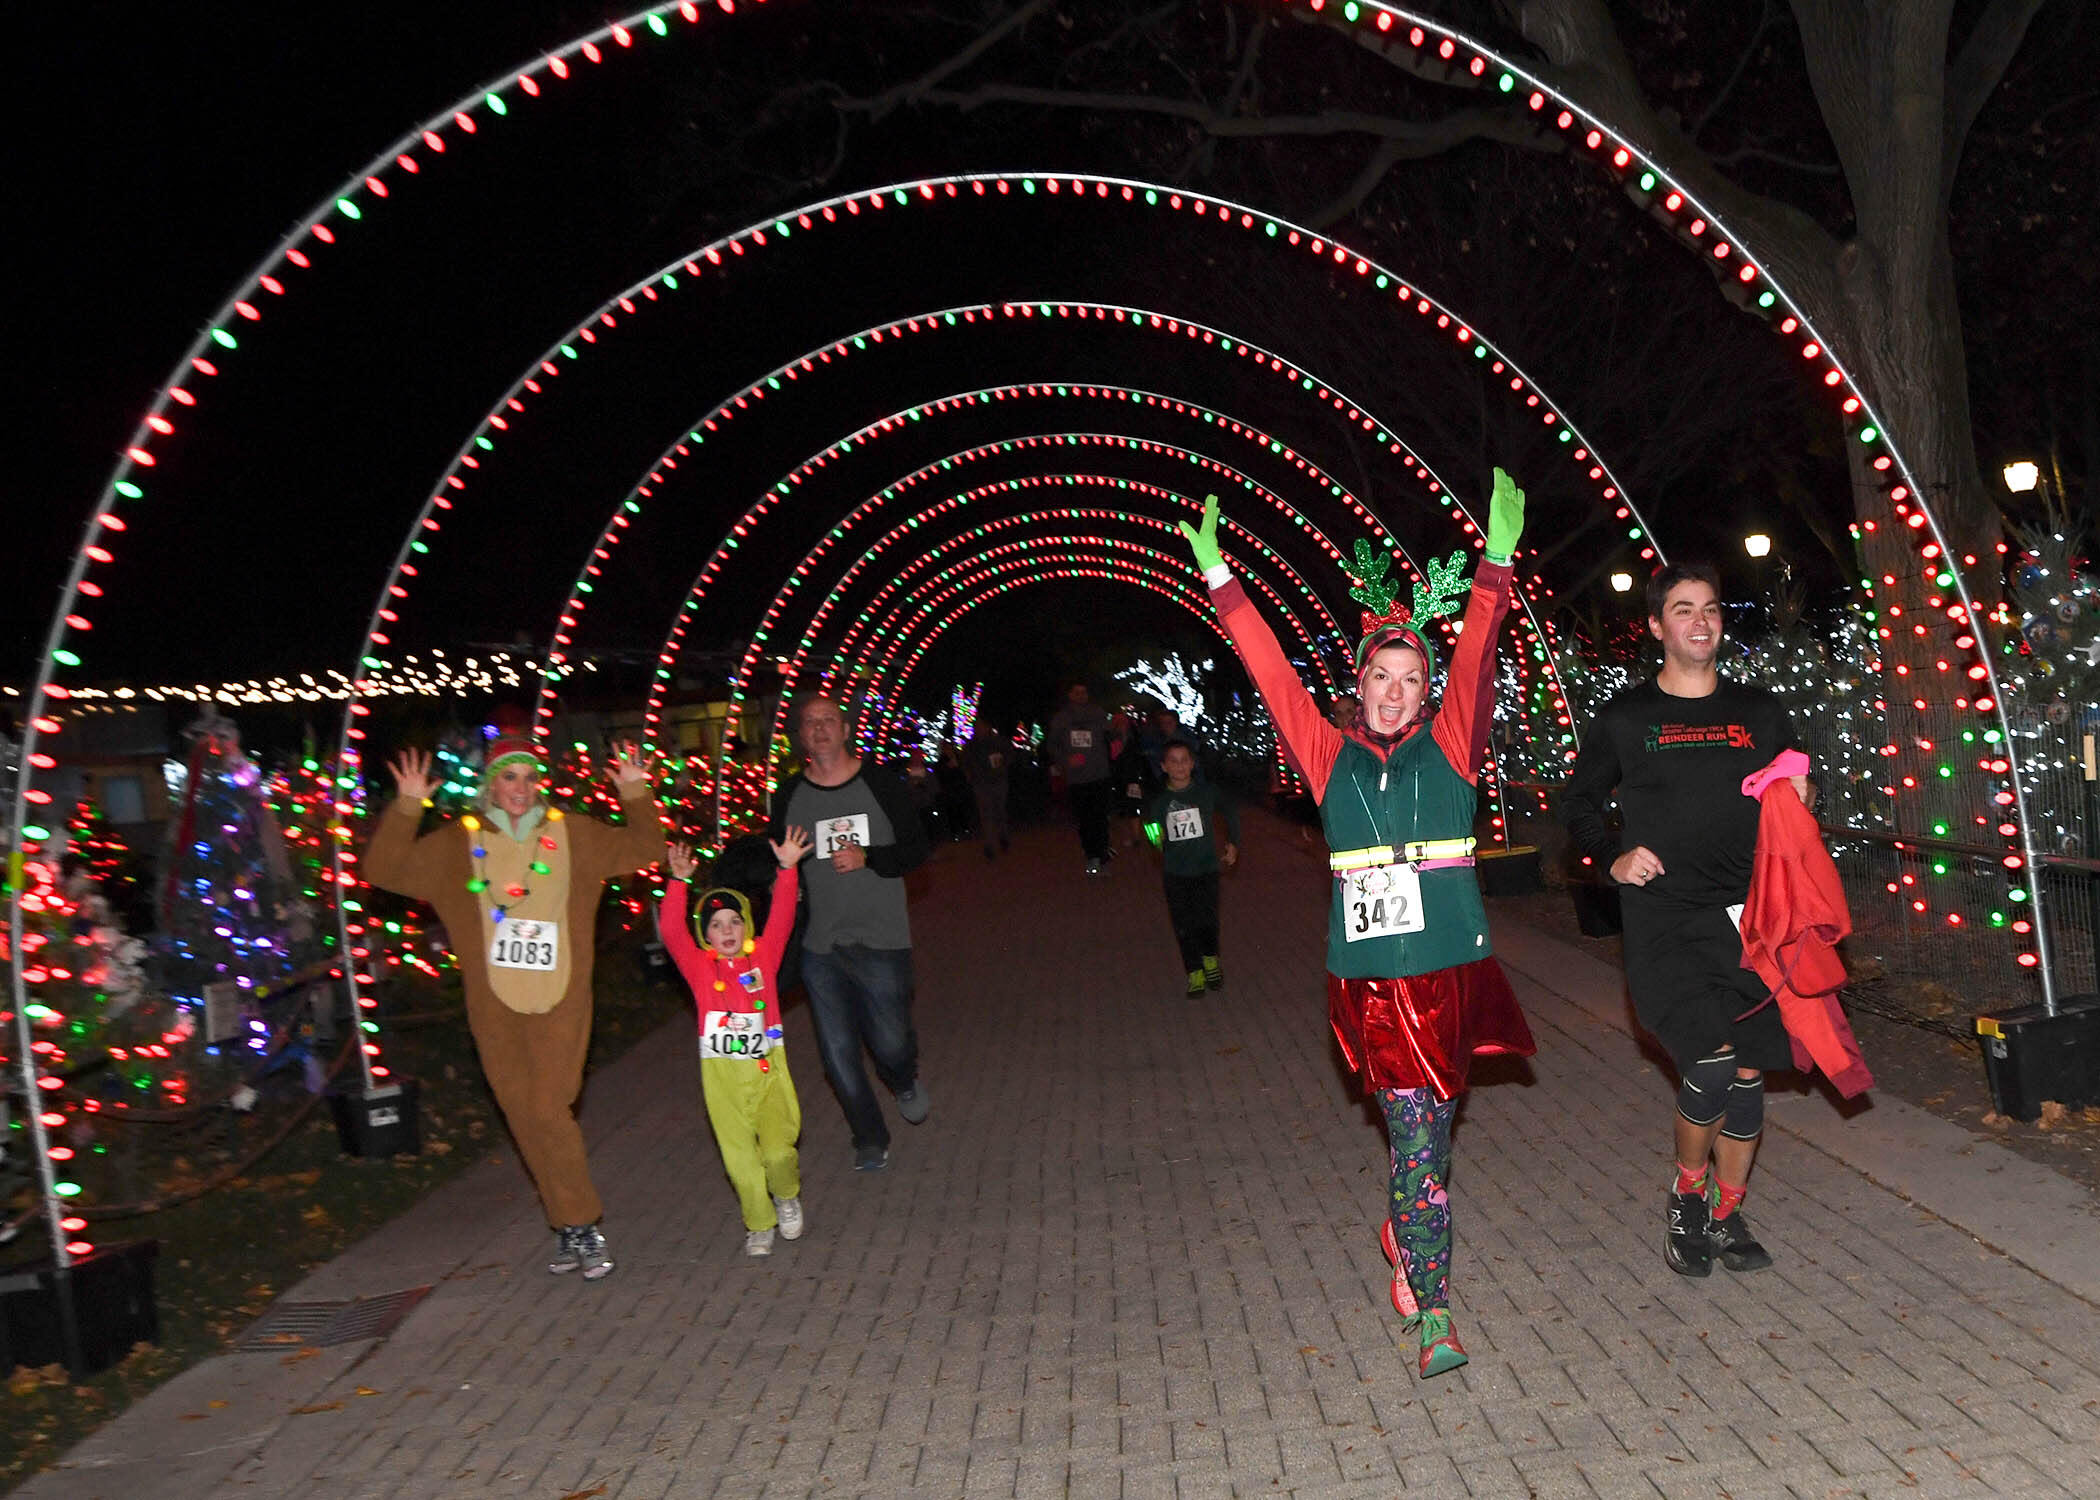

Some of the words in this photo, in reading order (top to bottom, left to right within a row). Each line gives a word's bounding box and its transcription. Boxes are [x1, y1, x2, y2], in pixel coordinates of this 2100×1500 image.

[1659, 733, 1705, 744] REINDEER
[1706, 733, 1727, 741] RUN
[1174, 822, 1197, 838] 174
[1353, 895, 1410, 933] 342
[496, 939, 552, 965] 1083
